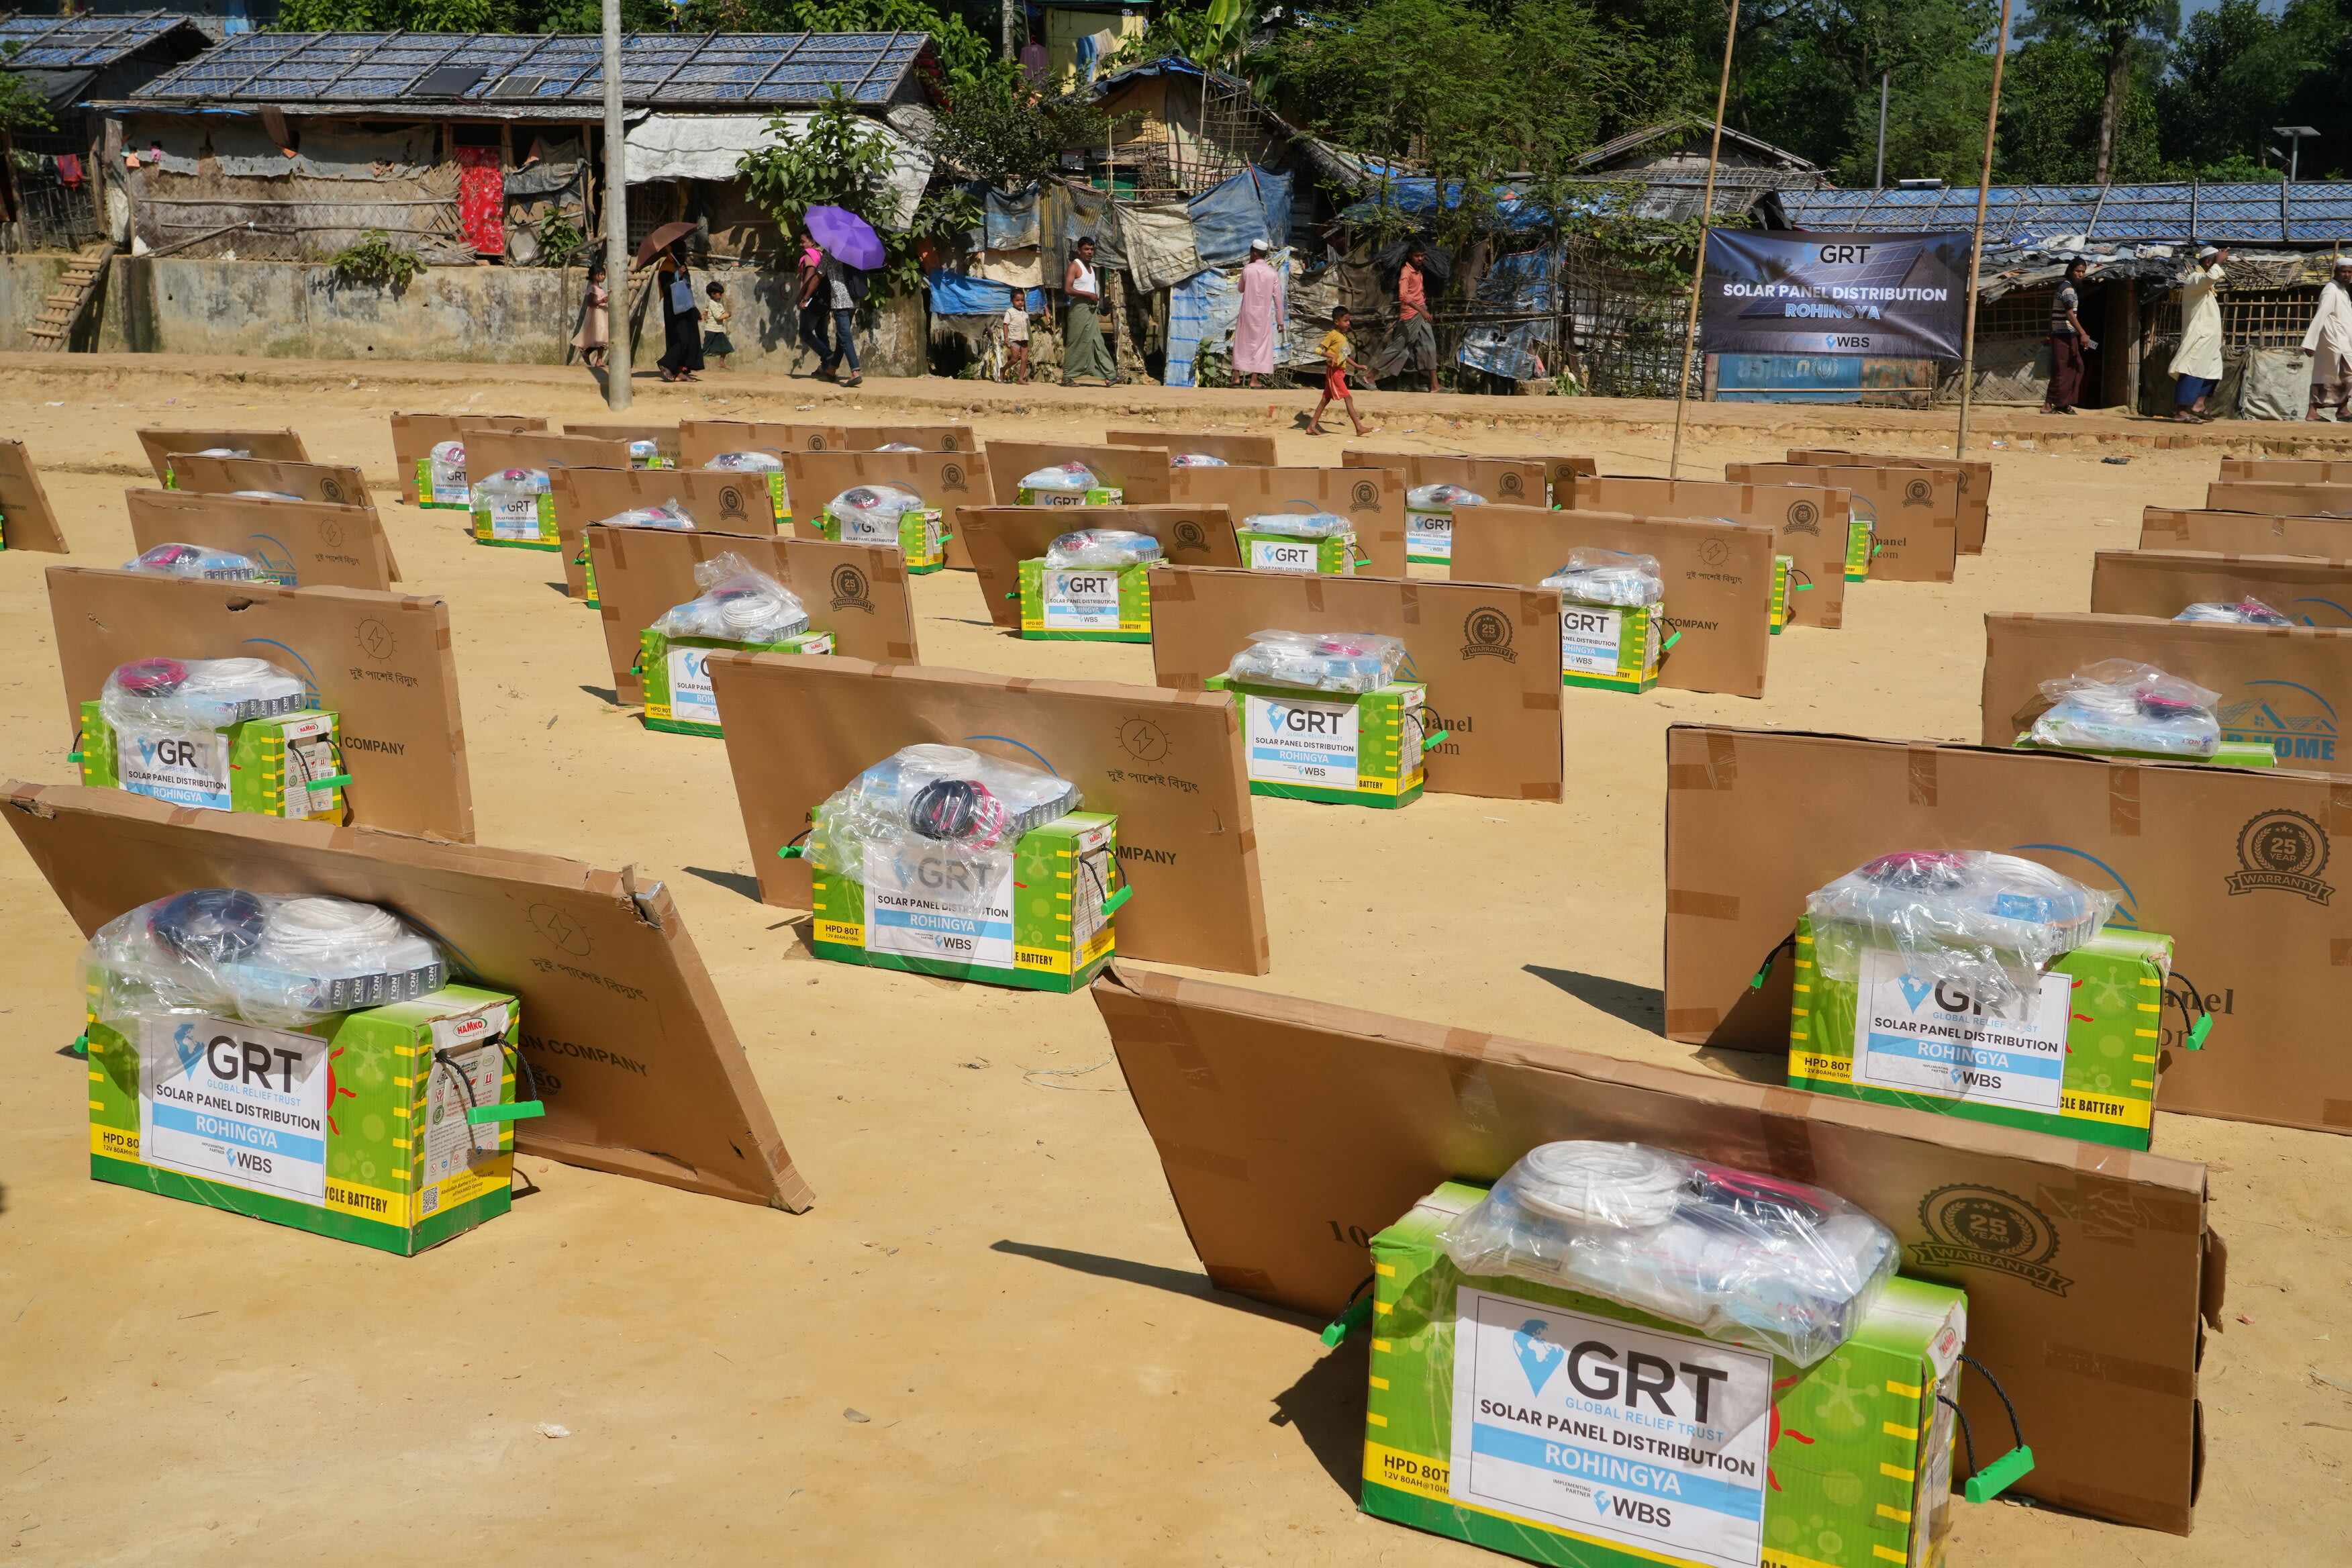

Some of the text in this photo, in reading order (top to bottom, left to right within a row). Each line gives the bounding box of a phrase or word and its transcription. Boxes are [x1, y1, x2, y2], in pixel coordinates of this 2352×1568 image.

[1820, 245, 1871, 264] GRT
[1723, 284, 1947, 301] SOLAR PANEL DISTRIBUTION
[1785, 303, 1880, 320] ROHINGYA
[1836, 336, 1869, 348] WBS
[507, 500, 530, 512] GRT
[1054, 497, 1079, 505] GRT
[1424, 518, 1452, 531] GRT
[1876, 537, 1906, 546] panel
[1275, 548, 1308, 563] GRT
[844, 579, 856, 587] 25
[1070, 577, 1108, 593] GRT
[1481, 624, 1496, 634] 25
[1564, 612, 1609, 633] GRT
[1668, 618, 1718, 630] COMPANY
[1469, 646, 1508, 655] WARRANTY
[1577, 638, 1616, 647] DISTRIBUTION
[1576, 656, 1593, 665] WBS
[349, 667, 419, 688] দুই পাশেই বিদ্যুৎ
[300, 723, 316, 732] HAMKO
[1286, 709, 1344, 734] GRT
[345, 736, 405, 756] COMPANY
[1255, 737, 1279, 745] SOLAR
[1304, 742, 1354, 752] DISTRIBUTION
[1279, 750, 1329, 763] ROHINGYA
[128, 771, 227, 790] SOLAR PANEL DISTRIBUTION
[1305, 767, 1326, 777] WBS
[1106, 769, 1199, 794] দুই পাশেই বিদ্যুৎ
[1359, 780, 1383, 789] BATTERY
[153, 787, 203, 803] ROHINGYA
[2270, 837, 2297, 854] 25
[2269, 852, 2297, 862] YEAR
[918, 856, 994, 893] GRT
[2243, 874, 2318, 891] WARRANTY
[877, 895, 940, 910] SOLAR PANEL
[826, 924, 859, 935] HPD 80T
[910, 914, 975, 932] ROHINGYA
[944, 936, 972, 950] WBS
[1021, 952, 1053, 966] BATTERY
[373, 975, 381, 999] NO.1
[530, 957, 648, 1002] দুই পাশেই বিদ্যুৎ
[333, 980, 342, 1006] NO.1
[456, 1020, 483, 1035] HAMKO
[1932, 1011, 1969, 1024] GLOBAL
[1973, 1017, 2006, 1028] RELIEF
[1874, 1017, 2058, 1052] SOLAR PANEL DISTRIBUTION
[548, 1039, 648, 1077] COMPANY
[1918, 1042, 2009, 1068] ROHINGYA
[207, 1035, 302, 1093] GRT
[1805, 1057, 1851, 1071] HPD 80T
[1816, 1069, 1851, 1079] 80AH@10Hr
[1963, 1071, 2002, 1089] WBS
[207, 1079, 301, 1107] GLOBAL RELIEF TRUST
[156, 1083, 320, 1132] SOLAR PANEL DISTRIBUTION
[2079, 1099, 2125, 1117] BATTERY
[103, 1132, 140, 1148] HPD 80
[196, 1115, 279, 1149] ROHINGYA
[209, 1147, 225, 1155] PARTNER
[237, 1151, 273, 1174] WBS
[348, 1191, 387, 1214] BATTERY
[1970, 1213, 2008, 1236] 25
[1968, 1229, 2010, 1244] YEAR
[1934, 1246, 2046, 1279] WARRANTY
[1567, 1340, 1728, 1424] GRT
[1565, 1397, 1724, 1442] GLOBAL RELIEF TRUST
[1480, 1399, 1755, 1477] SOLAR PANEL DISTRIBUTION
[1384, 1454, 1450, 1483] HPD 80T
[1545, 1443, 1681, 1496] ROHINGYA
[1383, 1471, 1450, 1495] 12V 80AH@10Hr
[1552, 1478, 1591, 1493] IMPLEMENTING
[1565, 1487, 1591, 1498] PARTNER
[1612, 1495, 1671, 1528] WBS
